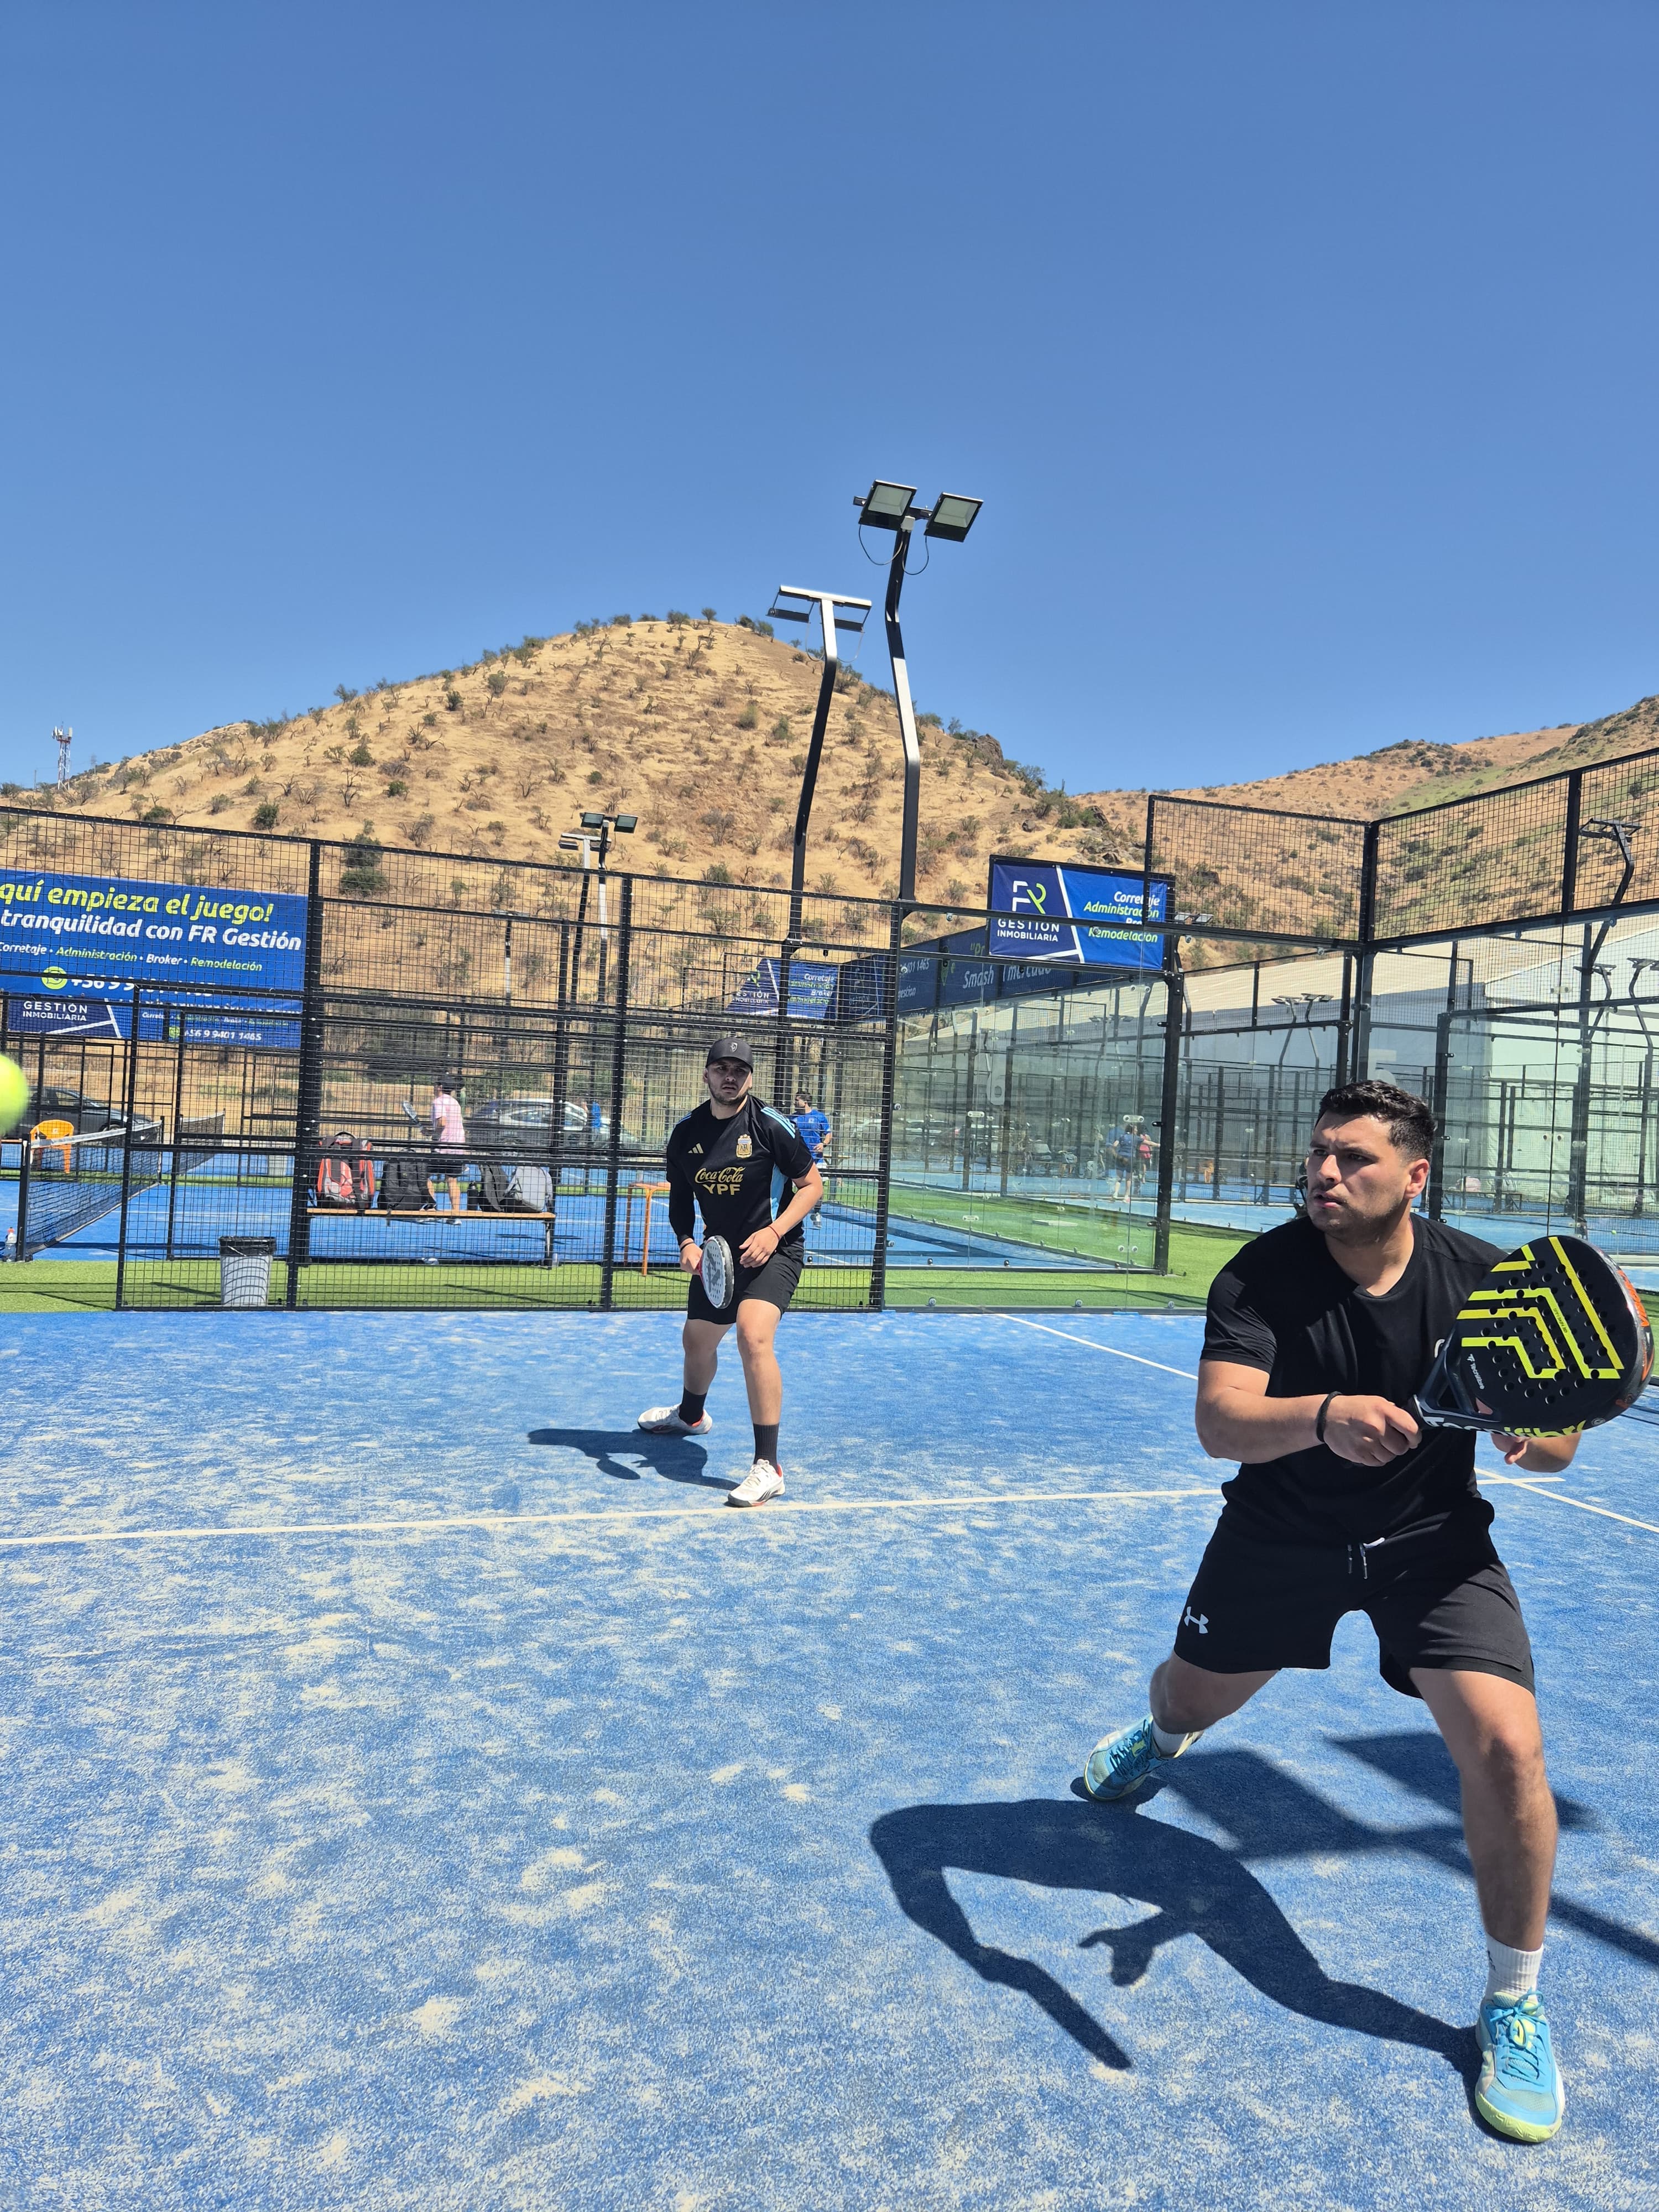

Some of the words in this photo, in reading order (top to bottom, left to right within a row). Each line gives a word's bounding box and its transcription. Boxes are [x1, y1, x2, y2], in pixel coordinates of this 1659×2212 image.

[48, 887, 159, 912] empieza
[166, 894, 190, 915] el
[190, 895, 274, 925] juego!
[1114, 891, 1160, 907] Corretje
[1083, 901, 1159, 918] Administracón
[1, 909, 143, 937] tranquilidad
[145, 925, 183, 941] con
[188, 925, 217, 943] FR
[222, 927, 301, 951] Gestión
[997, 930, 1058, 942] INMOBILIARIA
[55, 947, 137, 962] Administración
[146, 953, 183, 965] Broker
[190, 957, 262, 971] Remodelación
[963, 966, 994, 989] Smash
[23, 1001, 87, 1014] GESTIÓN
[23, 1011, 87, 1022] INMOBILIARIA
[695, 1166, 746, 1183] Coca-Cola
[702, 1183, 740, 1195] YPF
